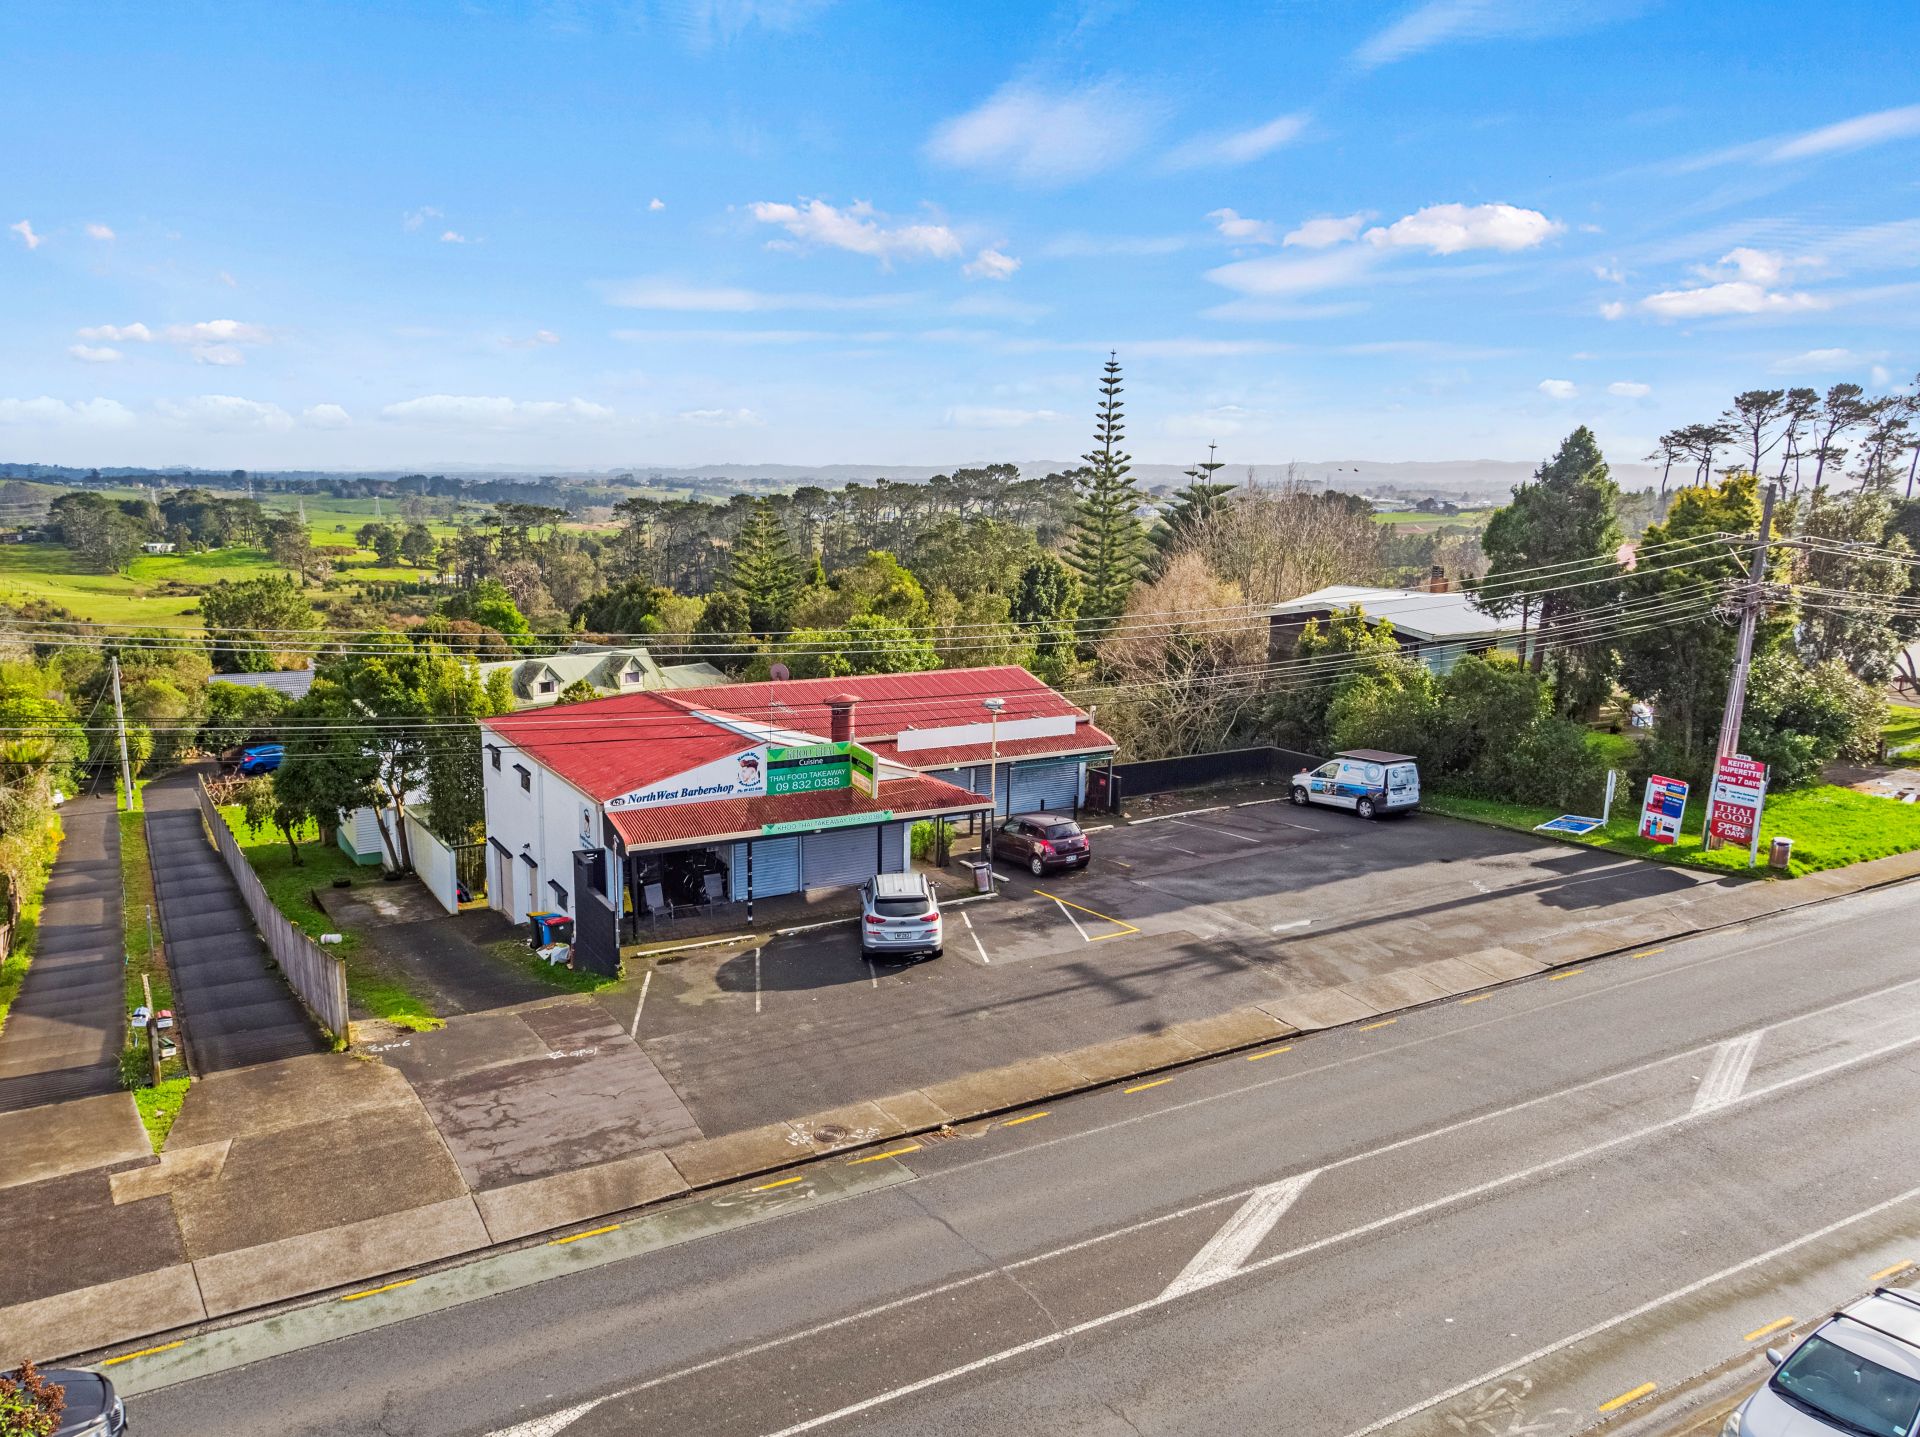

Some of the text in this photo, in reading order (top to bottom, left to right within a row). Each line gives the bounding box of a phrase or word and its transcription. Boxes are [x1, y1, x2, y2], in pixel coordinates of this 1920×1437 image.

[798, 758, 824, 766] Cuisine
[1727, 760, 1756, 770] KEITH'S
[787, 772, 808, 780] FOOD
[810, 769, 846, 778] TAKEAWAY
[1720, 765, 1761, 778] SUPERETTE
[776, 777, 840, 792] 09 832 0388
[1718, 774, 1761, 788] OPEN 7 DAYS
[628, 788, 678, 805] NorthWest
[681, 783, 734, 798] Barbershop
[1717, 803, 1752, 817] THAI
[815, 817, 848, 826] TAKEAWAY
[1714, 810, 1753, 825] FOOD
[1717, 822, 1745, 833] OPEN
[1724, 829, 1745, 839] DAYS
